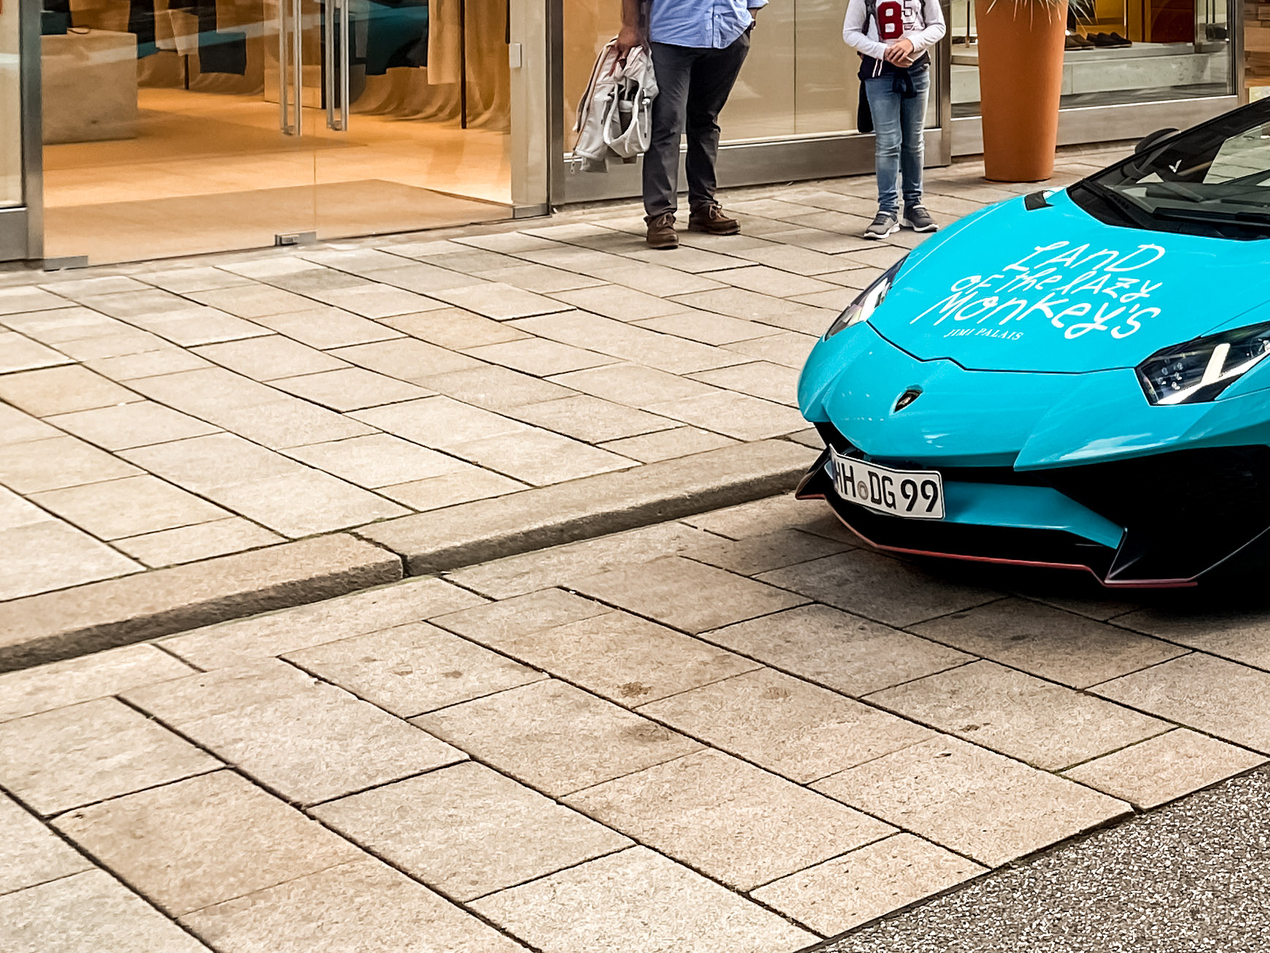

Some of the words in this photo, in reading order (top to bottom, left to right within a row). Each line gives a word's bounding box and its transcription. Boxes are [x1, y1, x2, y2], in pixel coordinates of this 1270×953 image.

[877, 1, 903, 39] 8
[975, 328, 1024, 341] PALAIS
[867, 470, 897, 510] DG
[900, 478, 939, 513] 99
